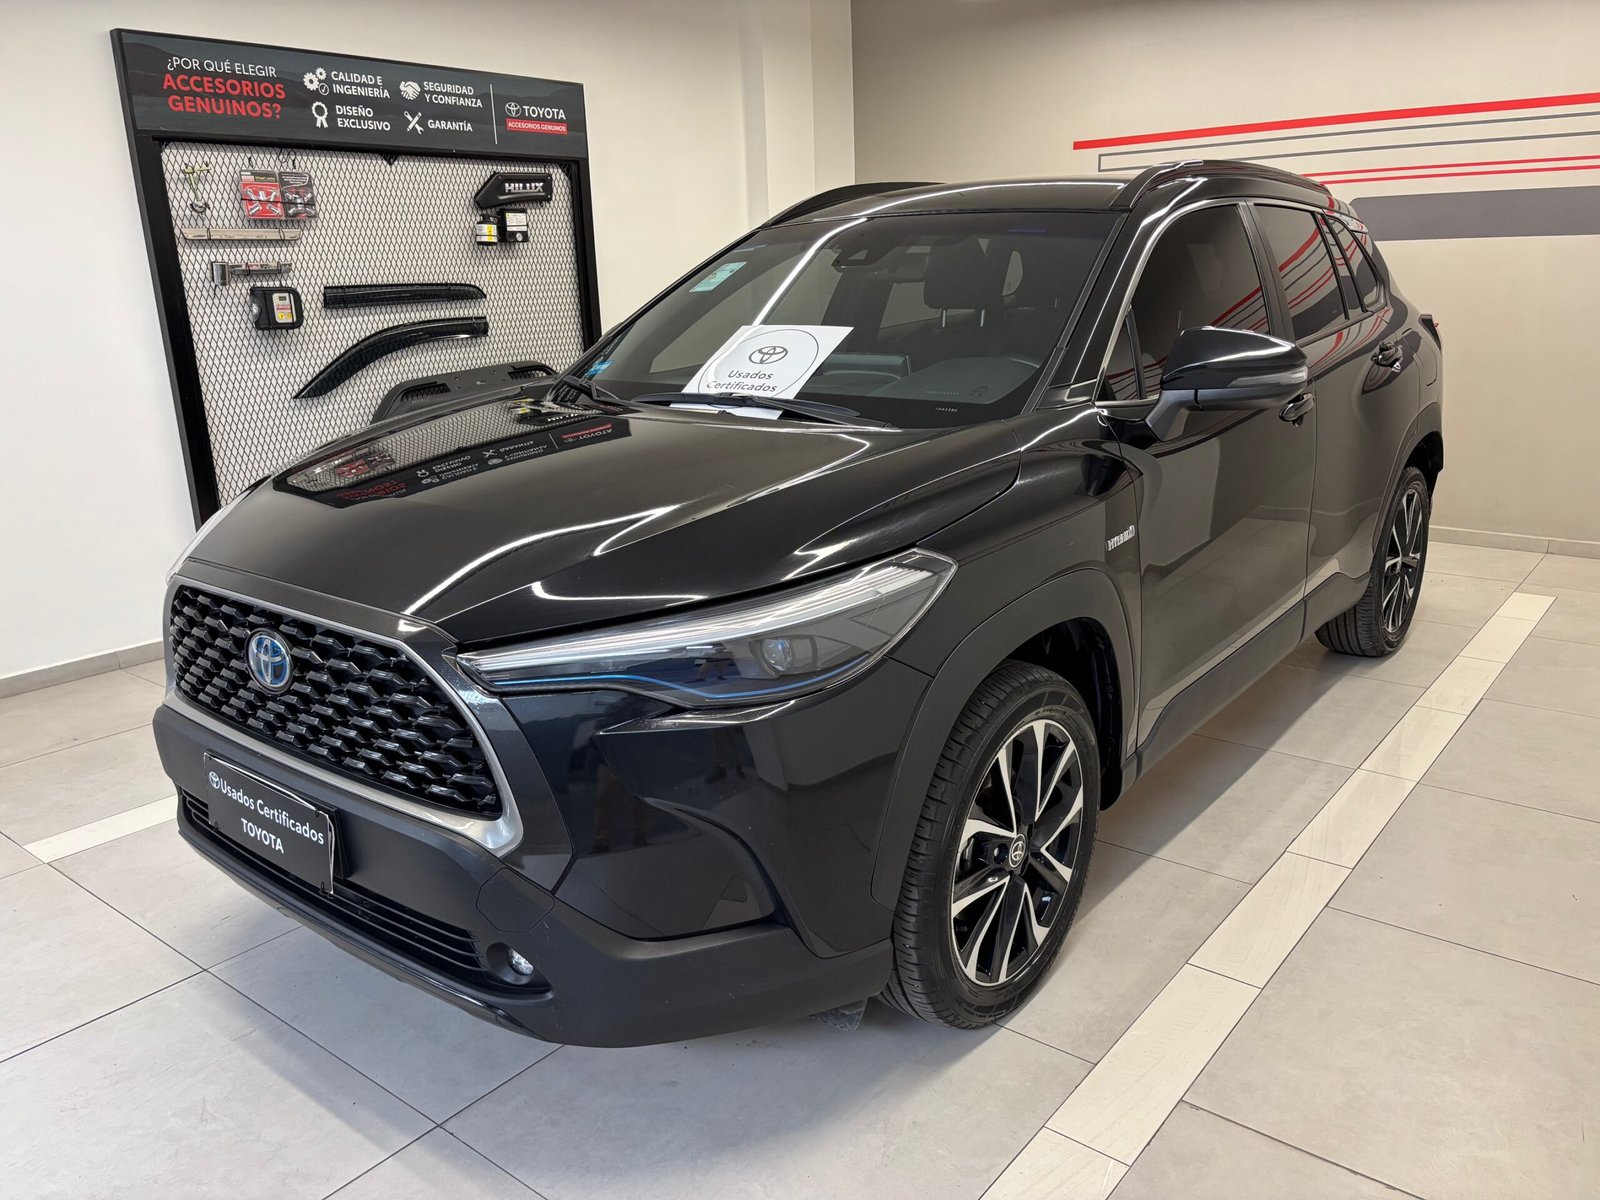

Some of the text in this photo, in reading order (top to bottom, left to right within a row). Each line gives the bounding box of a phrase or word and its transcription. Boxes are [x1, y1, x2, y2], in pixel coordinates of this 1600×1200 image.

[167, 56, 277, 78] ¿POR QUÉ ELEGIR
[163, 73, 286, 99] ACCESORIOS
[331, 71, 383, 86] CALIDAD E
[332, 83, 391, 99] INGENIERÍA
[423, 81, 474, 95] SEGURIDAD
[168, 94, 282, 119] GENUINOS?
[424, 93, 483, 108] Y CONFIANZA
[335, 105, 374, 118] DISEÑO
[522, 105, 567, 120] TOYOTA
[337, 117, 391, 131] EXCLUSIVO
[427, 119, 473, 132] GARANTÍA
[507, 121, 567, 132] ACCESORIOS GENUINOS
[504, 182, 544, 193] HILUX
[727, 369, 774, 380] Usados
[706, 380, 778, 393] Certificados
[220, 778, 325, 845] Usados Certificados
[240, 817, 285, 854] TOYOTA
